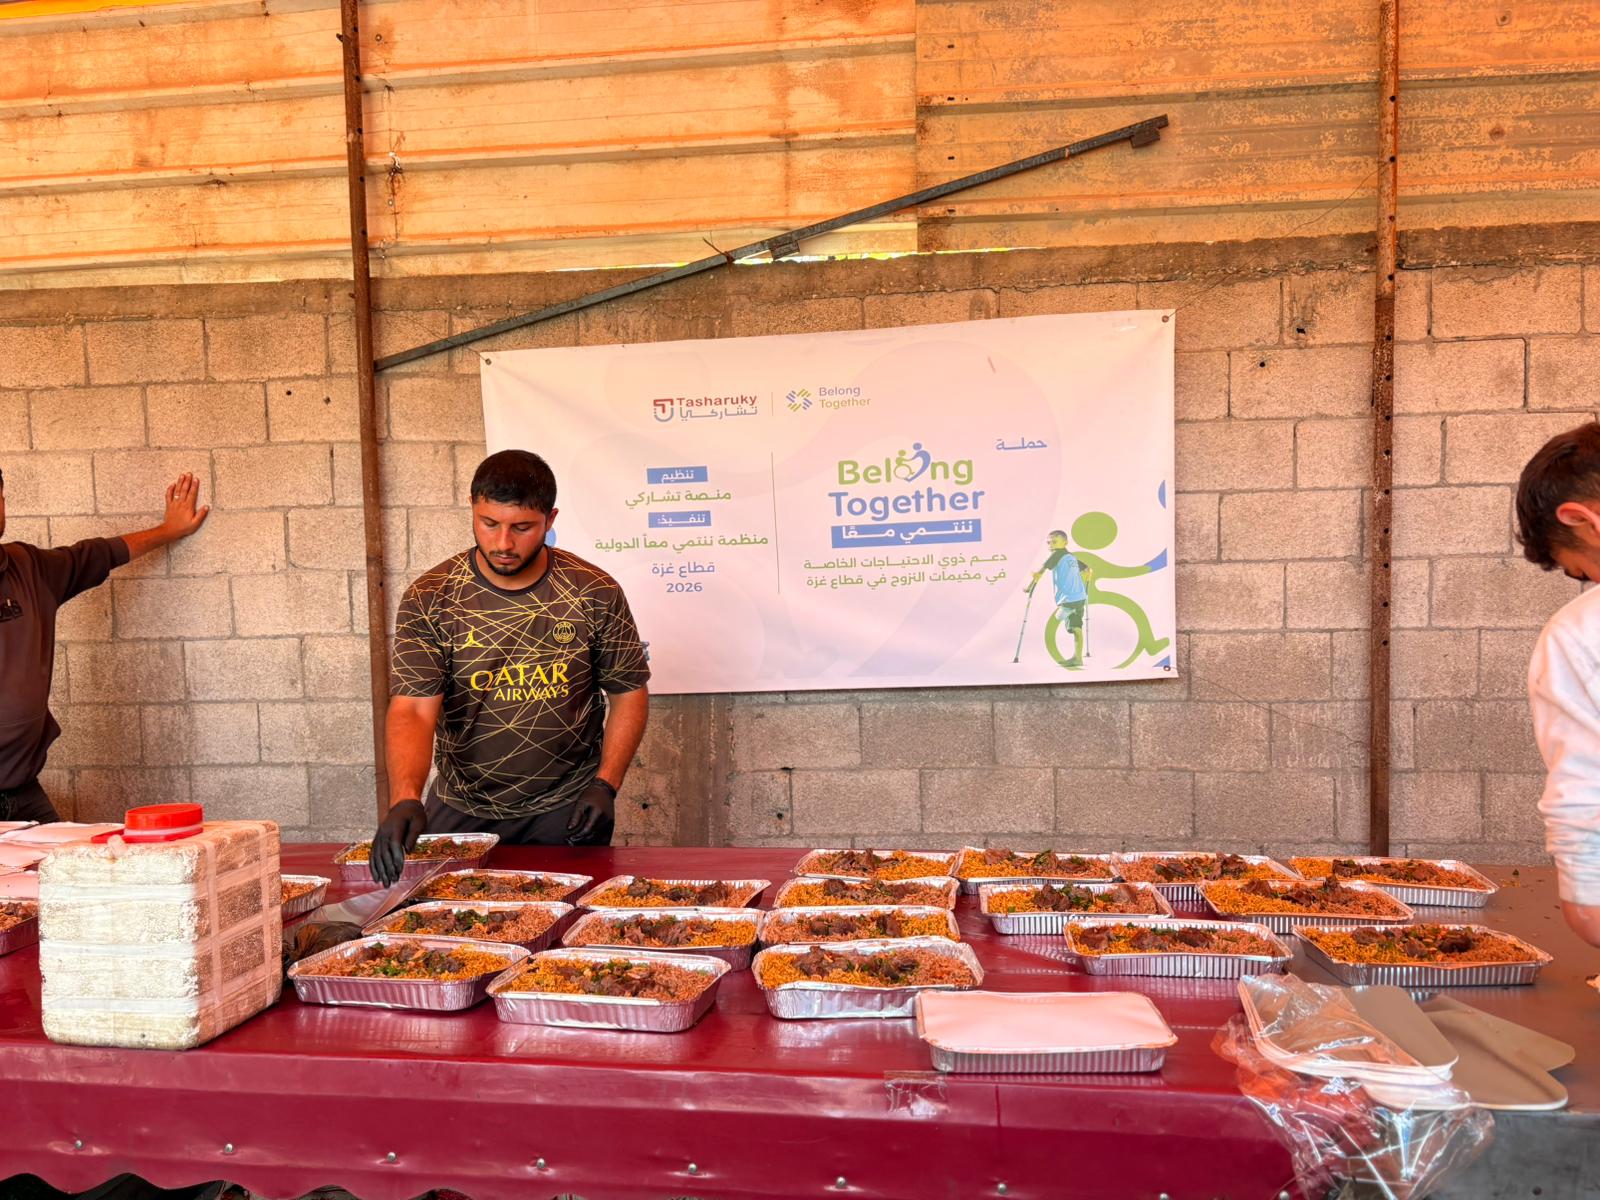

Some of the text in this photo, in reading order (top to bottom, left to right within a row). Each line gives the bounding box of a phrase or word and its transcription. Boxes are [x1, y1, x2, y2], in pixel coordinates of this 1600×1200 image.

[819, 386, 861, 398] Belong
[676, 395, 757, 407] Tasharuky
[819, 397, 871, 410] Together
[661, 469, 694, 483] تنظيم
[828, 487, 985, 521] Together
[595, 538, 640, 553] الدولية
[672, 536, 714, 554] ننتمي
[718, 534, 769, 547] منظمة
[938, 553, 966, 568] ذوي
[651, 561, 715, 578] قطاع غزة
[806, 570, 1006, 589] في مخيمات النزوح في قطاع غزة
[666, 582, 703, 593] 2026
[470, 661, 570, 691] QATAR
[493, 685, 570, 701] AIRWAYS
